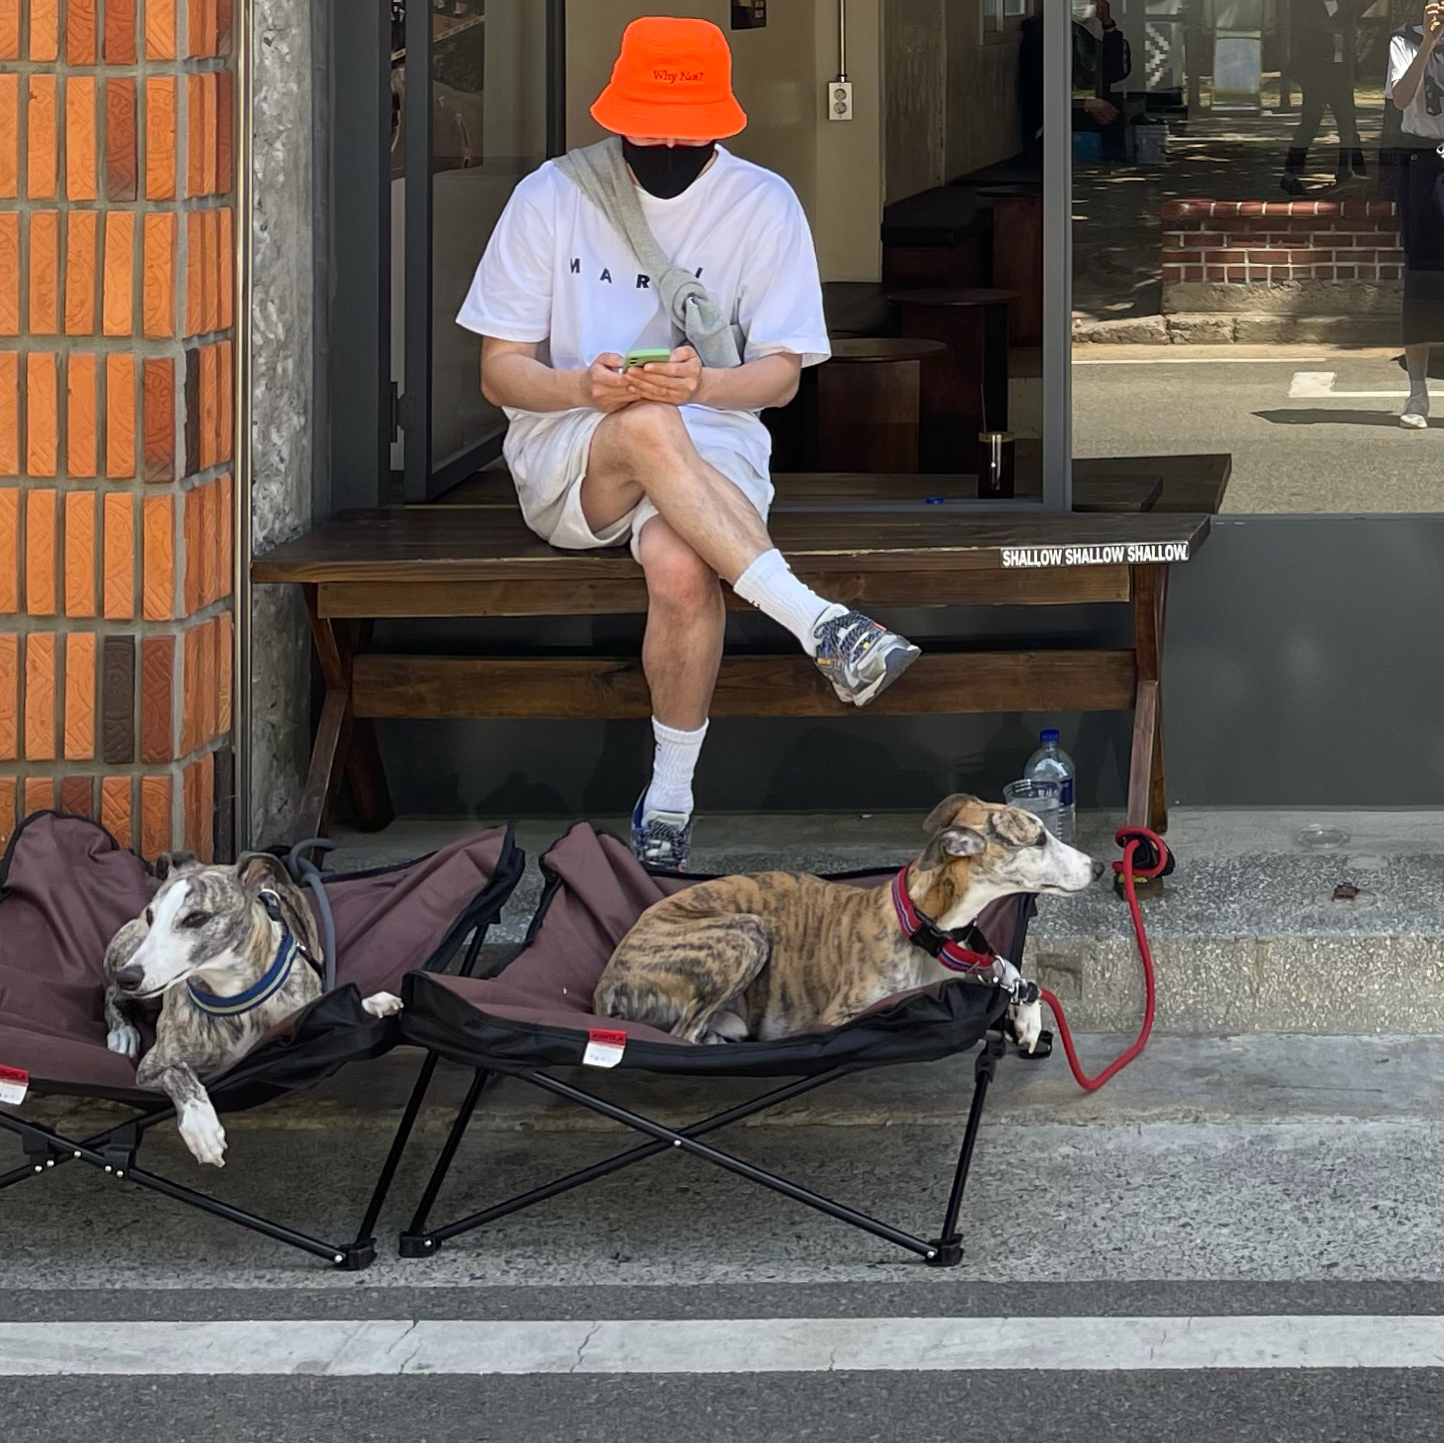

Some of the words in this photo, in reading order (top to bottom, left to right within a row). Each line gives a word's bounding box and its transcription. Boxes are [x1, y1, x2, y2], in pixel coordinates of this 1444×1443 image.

[653, 69, 677, 85] Why
[570, 258, 703, 289] MARI
[1002, 549, 1062, 567] SHALLOW
[1065, 547, 1124, 565] SHALLOW
[1127, 544, 1188, 562] SHALLOW
